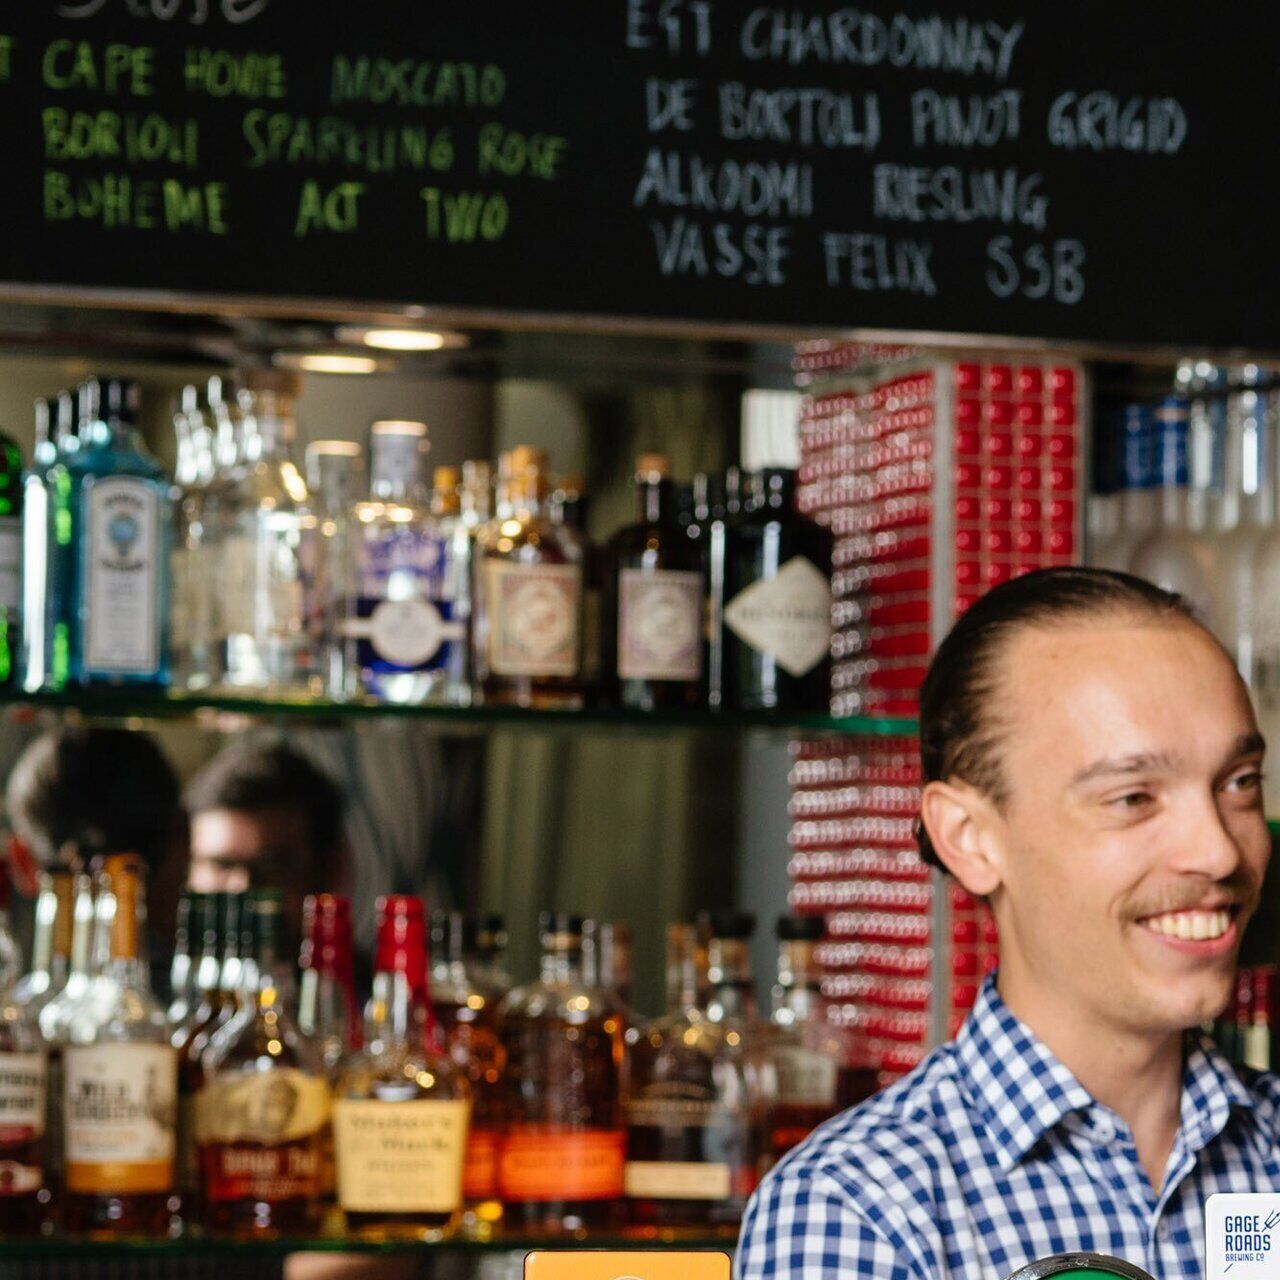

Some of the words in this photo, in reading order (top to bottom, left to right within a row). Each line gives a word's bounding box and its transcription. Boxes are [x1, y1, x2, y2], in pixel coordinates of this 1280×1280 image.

[42, 39, 154, 96] CAPE
[330, 54, 507, 107] MOSCATO
[741, 6, 1024, 79] CHARDONNAY
[646, 77, 695, 132] DE
[719, 81, 880, 150] BORTOLI
[912, 88, 1023, 147] PINOT
[478, 123, 569, 181] ROSE
[43, 170, 228, 235] BOHEME
[294, 179, 367, 237] ACT
[420, 187, 510, 243] TWO
[651, 217, 792, 286] VASSE
[823, 232, 937, 295] FELIX
[985, 235, 1086, 303] SSB
[1225, 1215, 1260, 1233] GAGE
[1225, 1234, 1271, 1252] ROADS
[1225, 1253, 1254, 1262] BREWING
